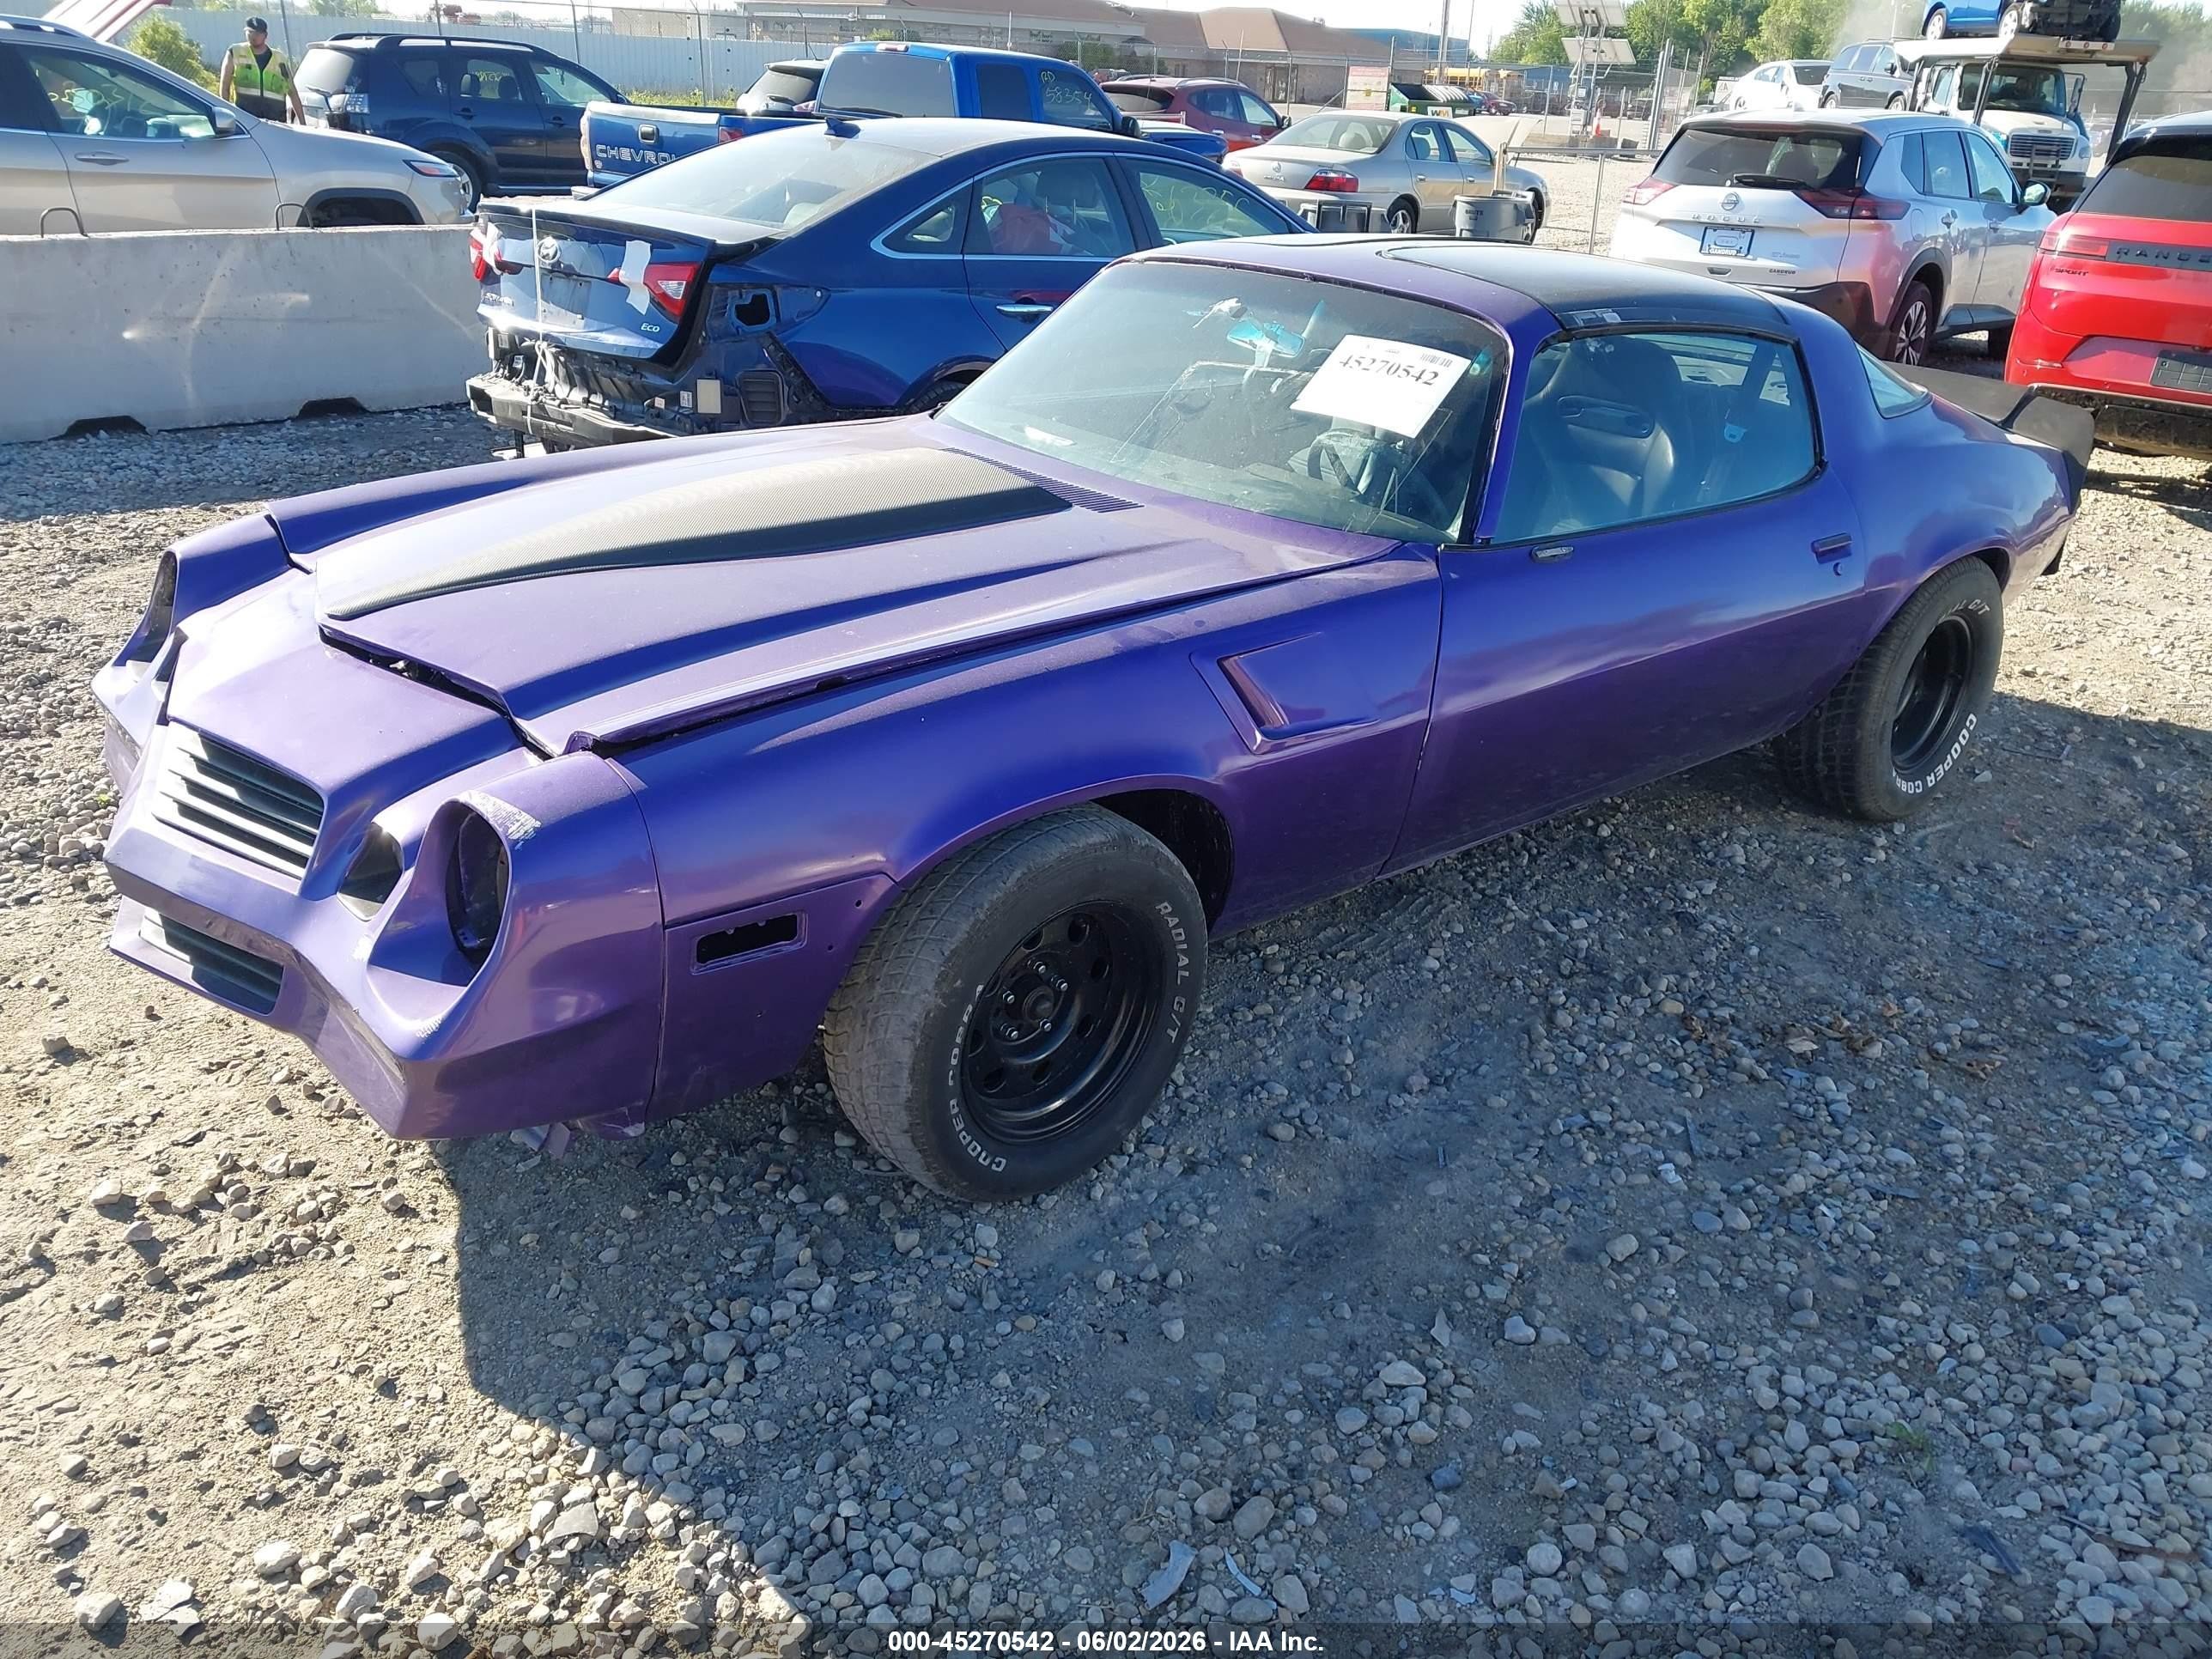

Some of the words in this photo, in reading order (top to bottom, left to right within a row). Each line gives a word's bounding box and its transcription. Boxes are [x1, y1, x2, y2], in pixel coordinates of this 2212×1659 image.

[2053, 268, 2089, 276] SPORT
[2116, 247, 2212, 263] RANGE
[1340, 355, 1439, 386] 45270542
[1926, 713, 1977, 787] COOPER
[1155, 902, 1189, 985] RADIAL
[1167, 996, 1186, 1043] G/T
[950, 1098, 1007, 1172] COOPER
